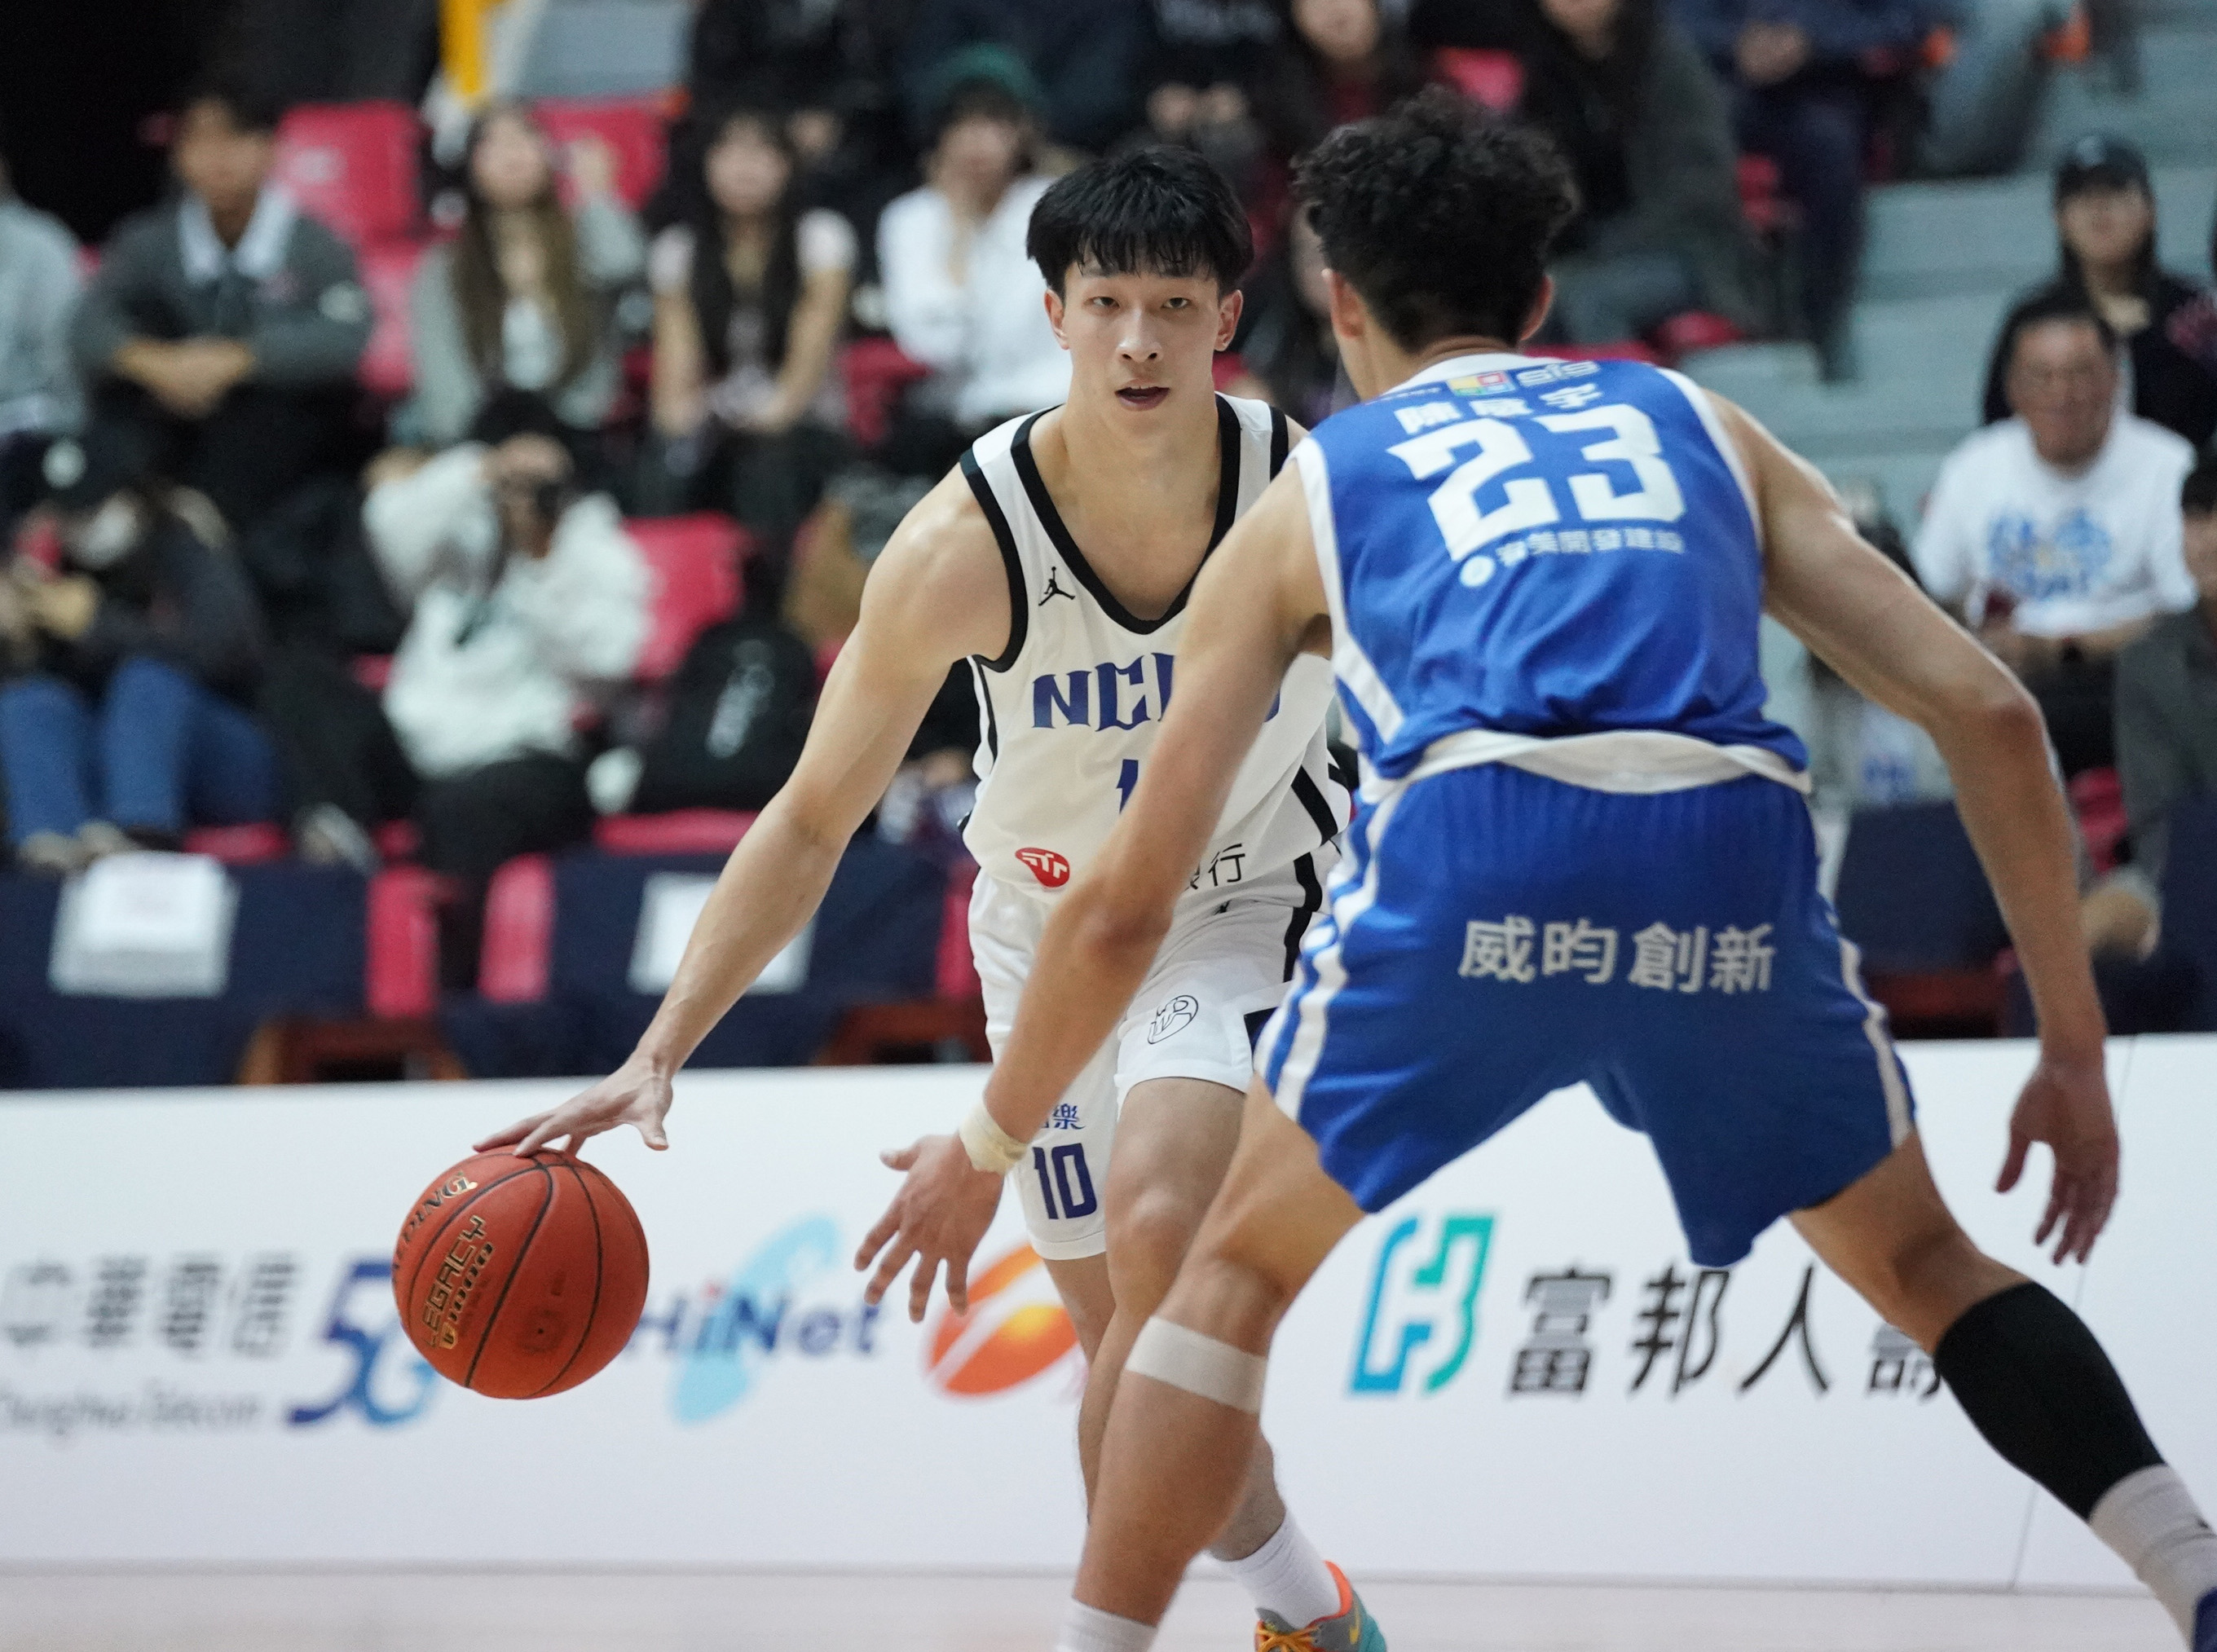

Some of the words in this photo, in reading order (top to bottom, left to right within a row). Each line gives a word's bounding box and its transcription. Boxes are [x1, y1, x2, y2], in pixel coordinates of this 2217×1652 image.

[1386, 403, 1686, 562] 23
[1457, 914, 1776, 994] 威昀創新
[1040, 1103, 1086, 1130] 樂
[1032, 1143, 1097, 1220] 10
[421, 1214, 487, 1350] LEGACY
[287, 1255, 441, 1430] 5G
